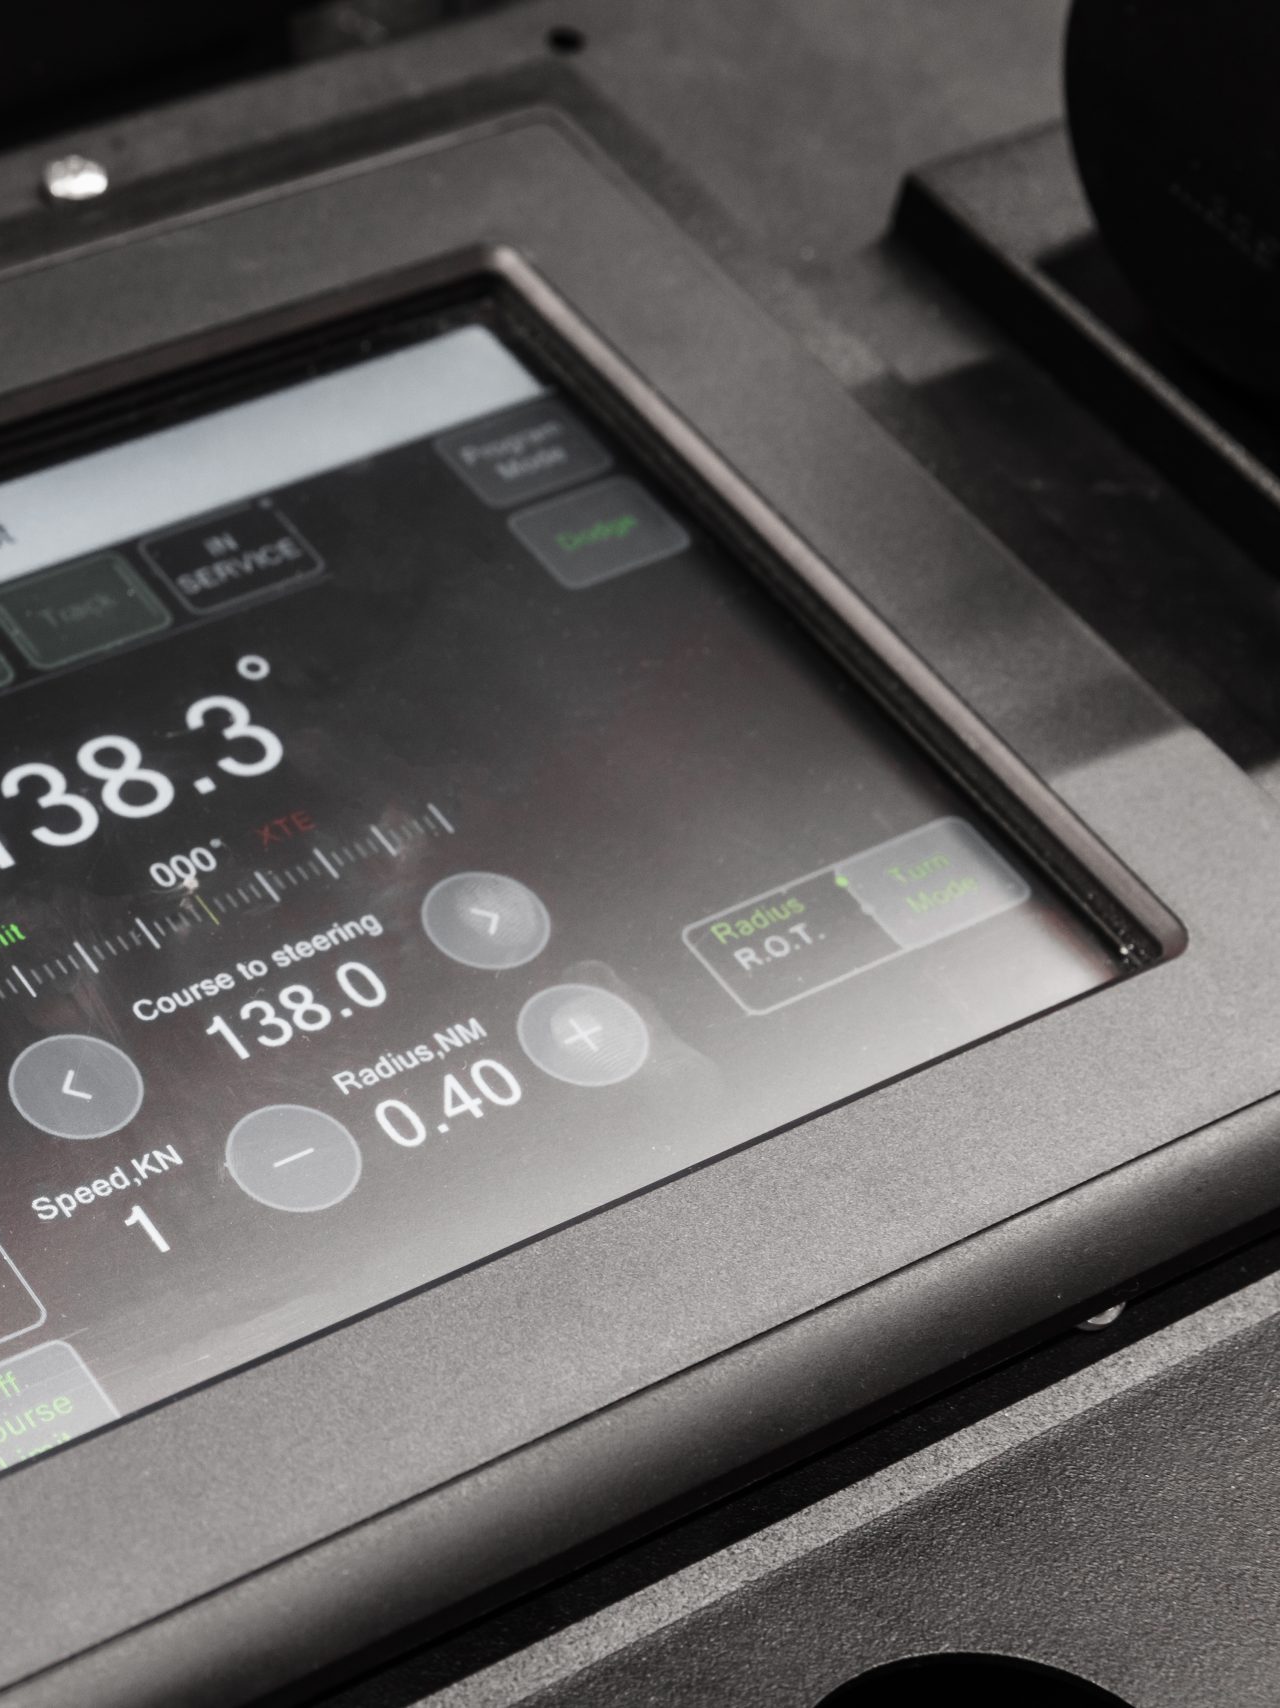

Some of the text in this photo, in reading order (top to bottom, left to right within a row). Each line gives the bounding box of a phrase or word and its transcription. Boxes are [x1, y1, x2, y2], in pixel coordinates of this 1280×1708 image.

[175, 536, 302, 596] SERVICE
[256, 810, 315, 846] XTE
[886, 853, 951, 885] Turn
[904, 876, 980, 915] Mode
[710, 897, 806, 944] Radius
[132, 913, 383, 1022] Course to steering
[734, 922, 826, 971] R.O.T.
[206, 961, 388, 1060] 138.0
[374, 1058, 523, 1148] 0.40
[124, 1205, 170, 1253] 1
